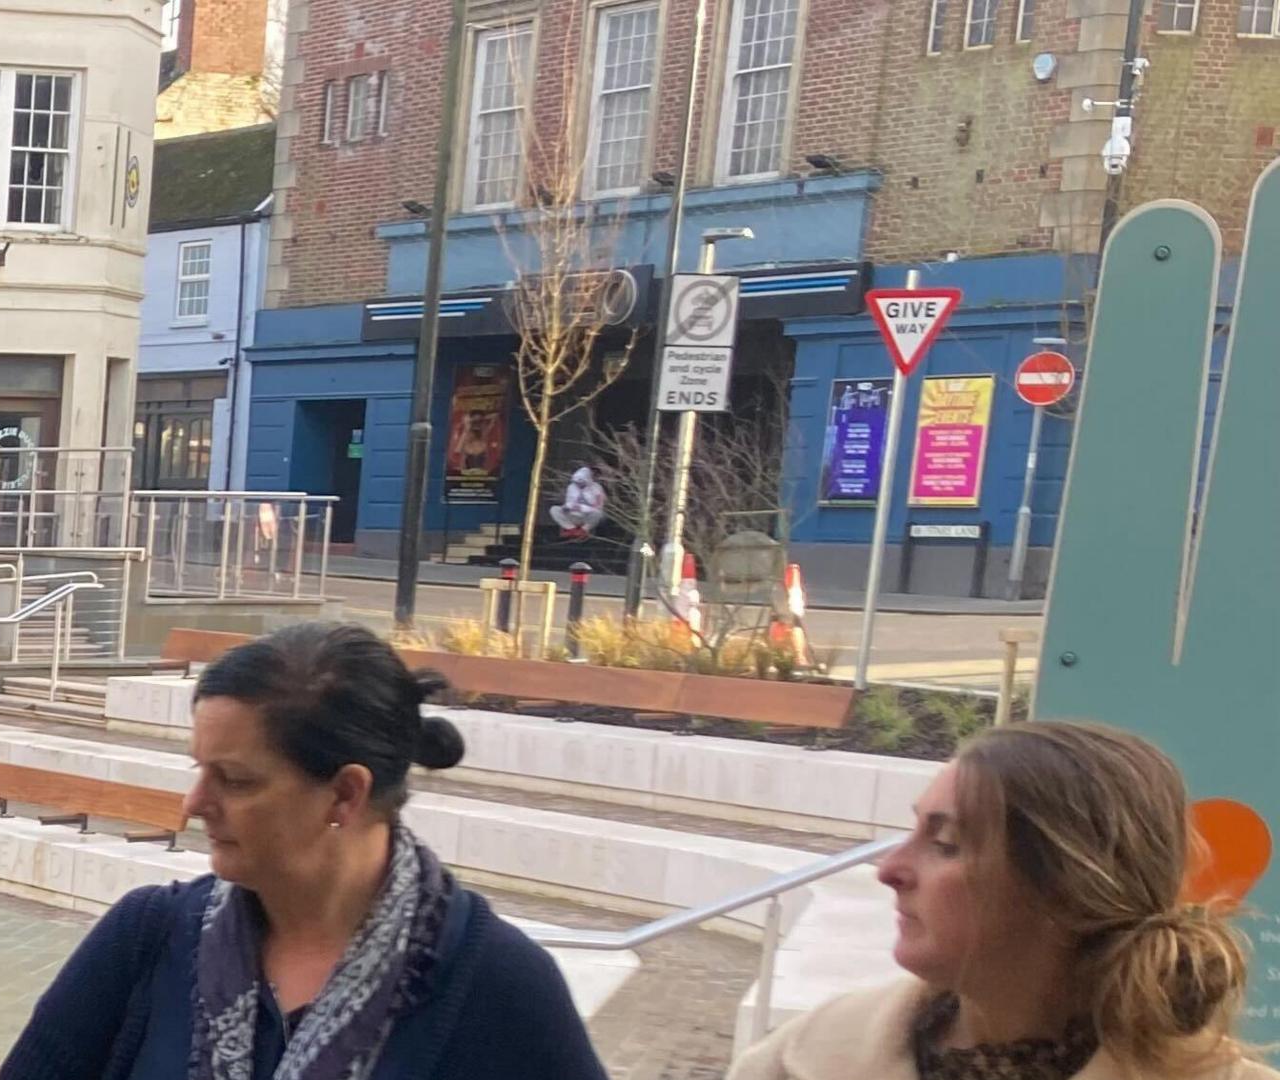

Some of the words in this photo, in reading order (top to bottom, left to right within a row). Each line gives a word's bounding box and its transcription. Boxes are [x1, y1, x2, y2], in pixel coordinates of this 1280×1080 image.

[886, 302, 938, 319] GIVE
[895, 322, 928, 334] WAY
[667, 350, 728, 362] Pedestrian
[668, 364, 690, 374] and
[693, 365, 723, 376] cycle
[679, 375, 708, 386] Zone
[665, 390, 719, 406] ENDS
